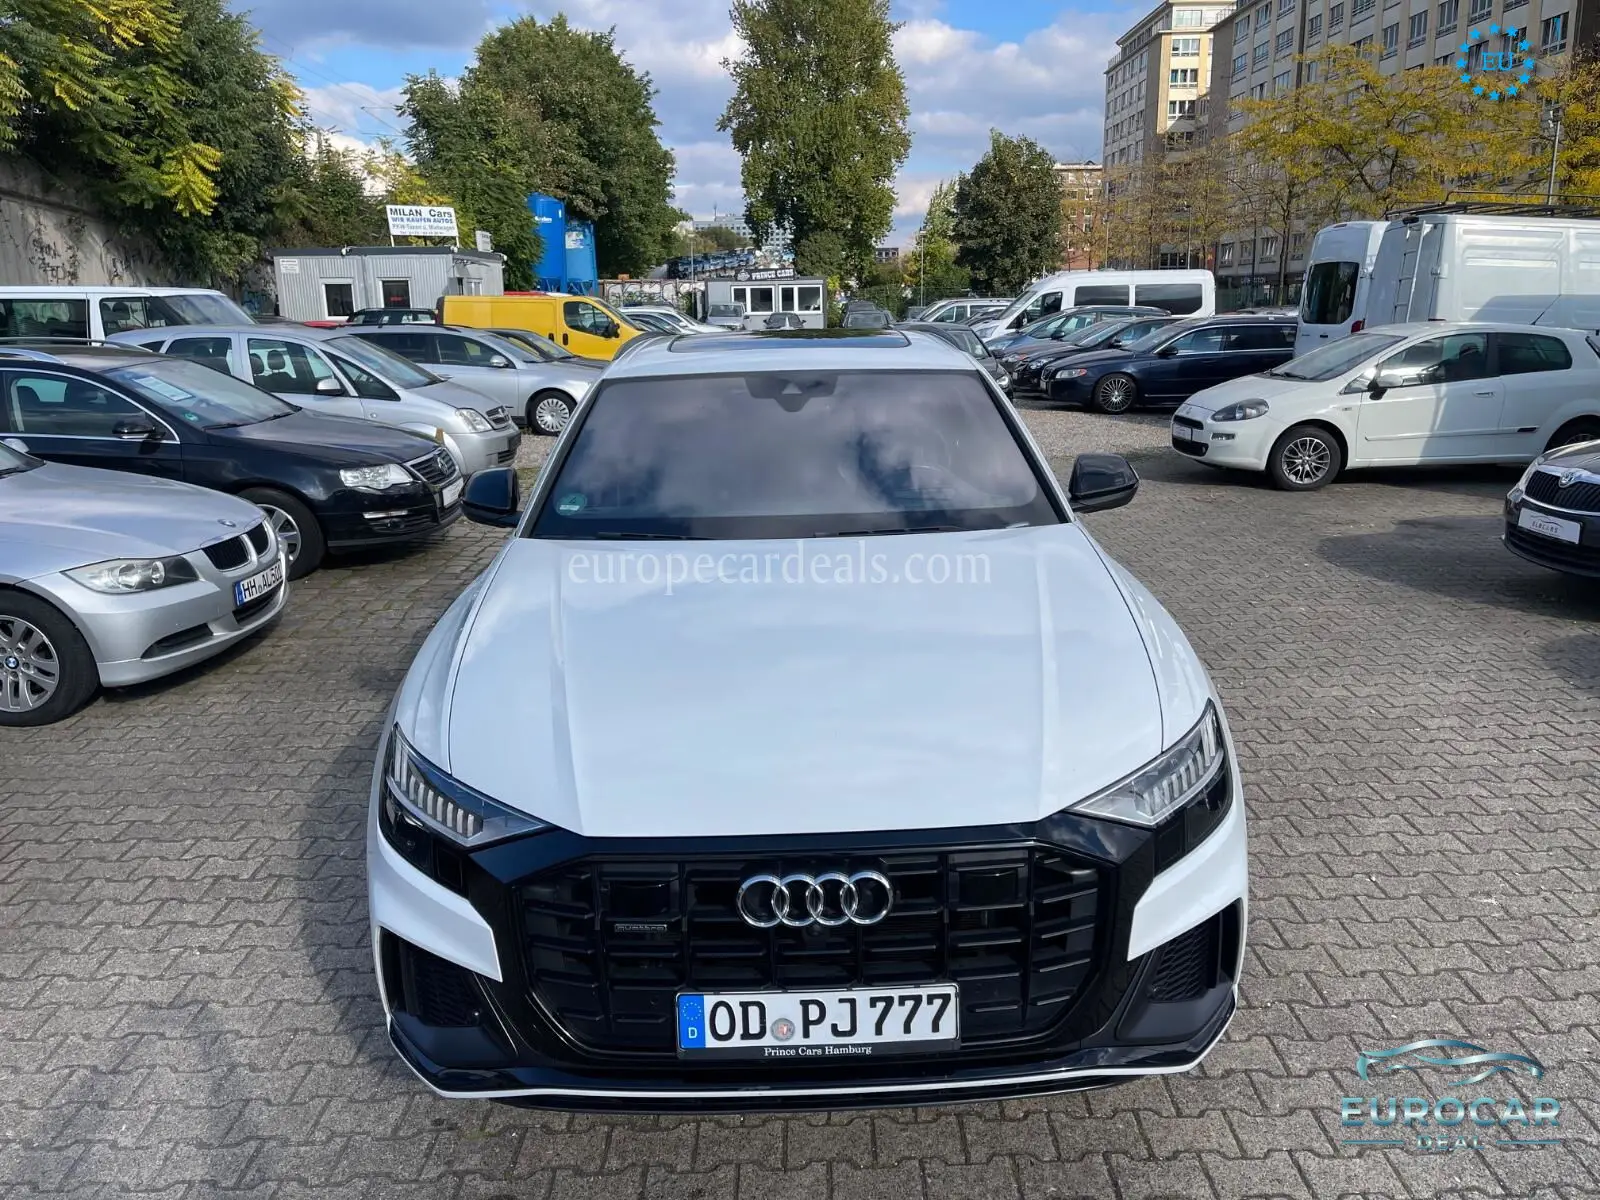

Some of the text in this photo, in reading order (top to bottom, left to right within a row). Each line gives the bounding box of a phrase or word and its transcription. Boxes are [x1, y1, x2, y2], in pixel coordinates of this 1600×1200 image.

[389, 207, 453, 218] MILAN Cars
[751, 269, 794, 280] PRINCE CARS
[242, 578, 258, 599] HH
[709, 993, 951, 1041] OD PJ 777
[688, 1027, 698, 1039] D
[764, 1045, 872, 1056] Prince Cars Hamburg
